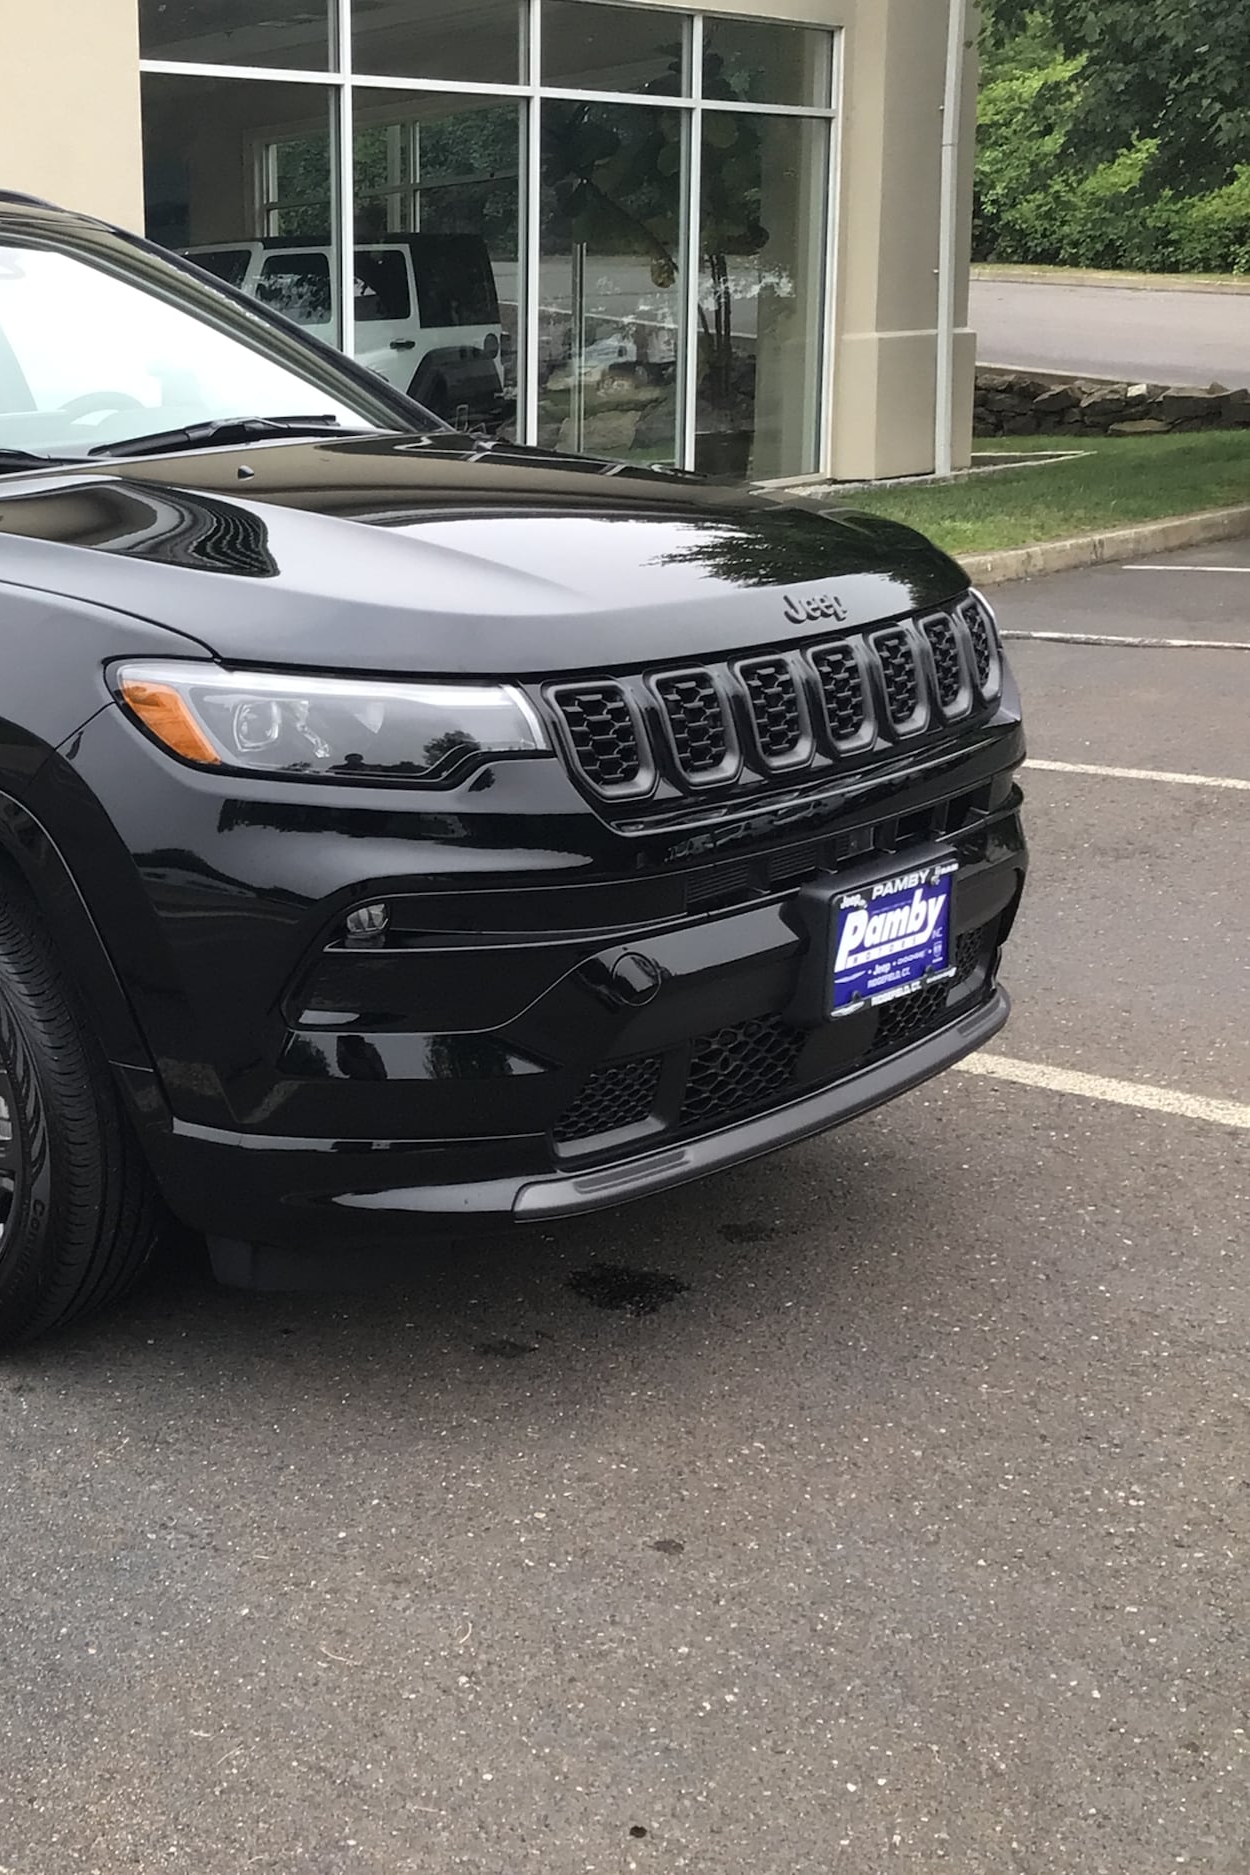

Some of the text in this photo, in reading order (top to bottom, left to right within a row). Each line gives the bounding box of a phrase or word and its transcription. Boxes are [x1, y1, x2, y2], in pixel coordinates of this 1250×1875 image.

[782, 594, 848, 625] Jeep
[872, 868, 930, 900] PAMBY
[834, 888, 947, 973] Pamby
